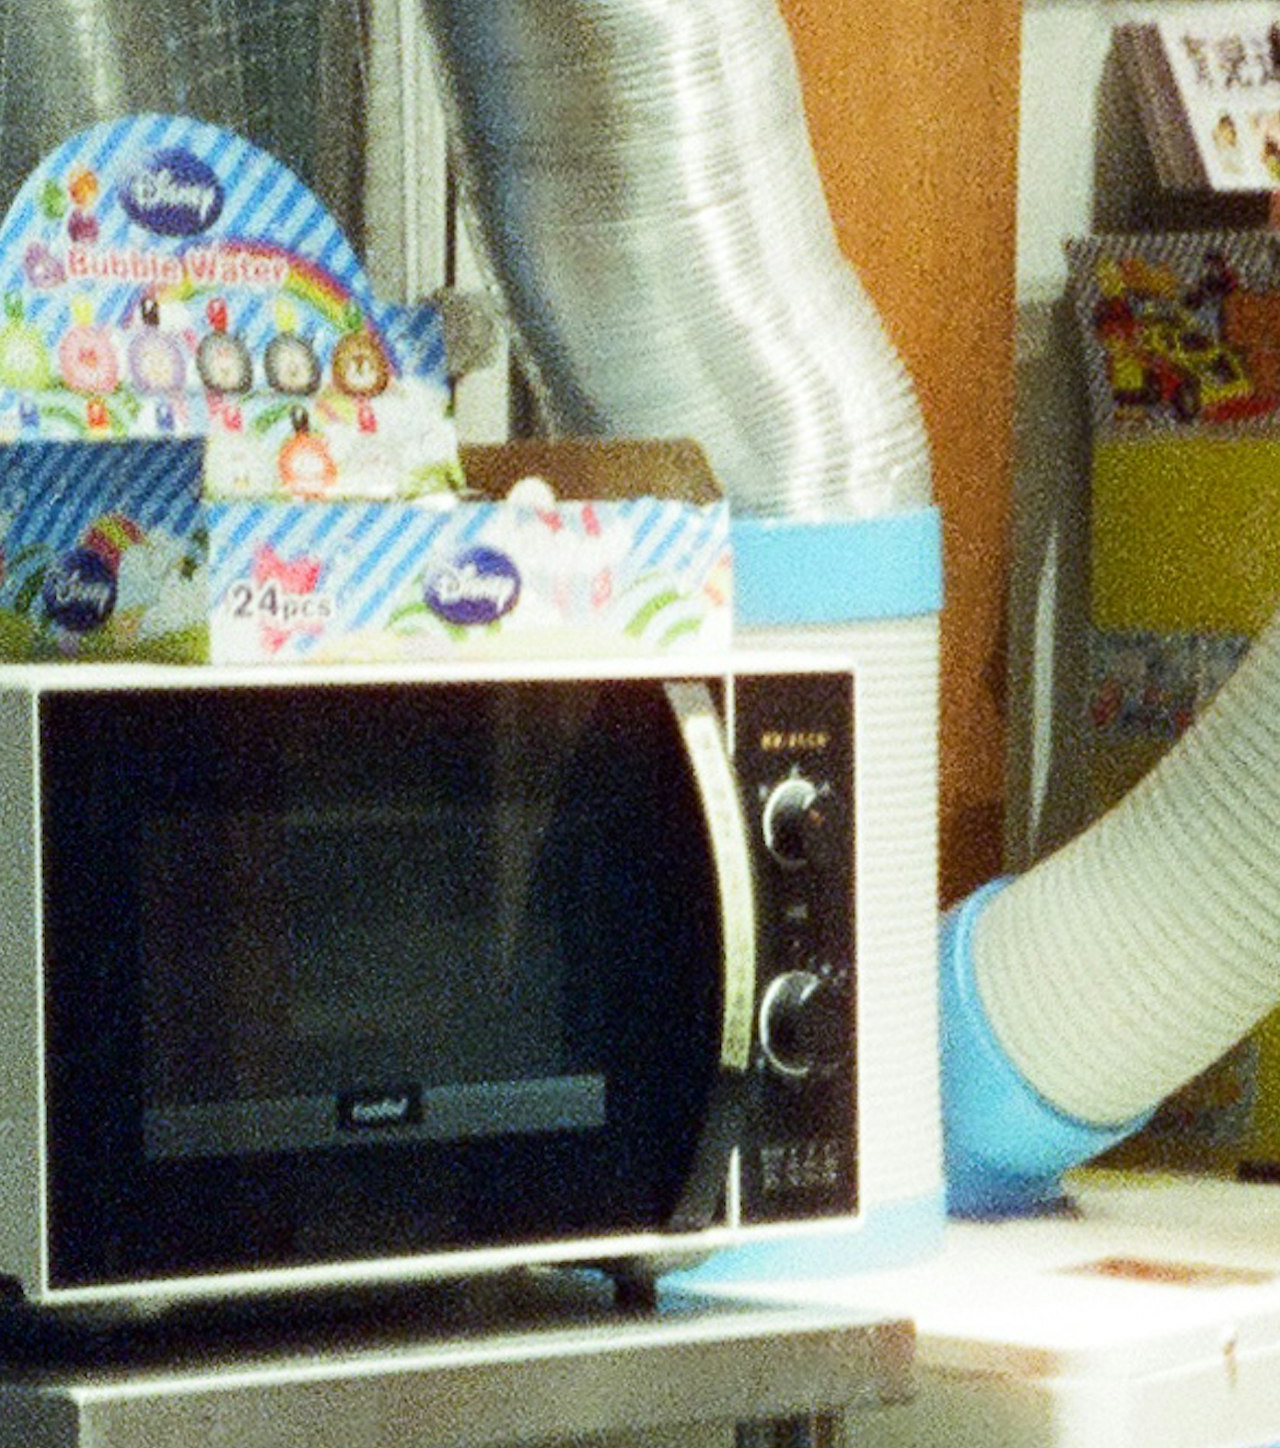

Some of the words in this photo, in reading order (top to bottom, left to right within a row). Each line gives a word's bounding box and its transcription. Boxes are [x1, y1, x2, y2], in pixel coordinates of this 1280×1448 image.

[125, 162, 218, 221] Disney
[67, 245, 181, 283] Bubble
[186, 245, 289, 283] Water
[231, 582, 335, 622] 24pcs
